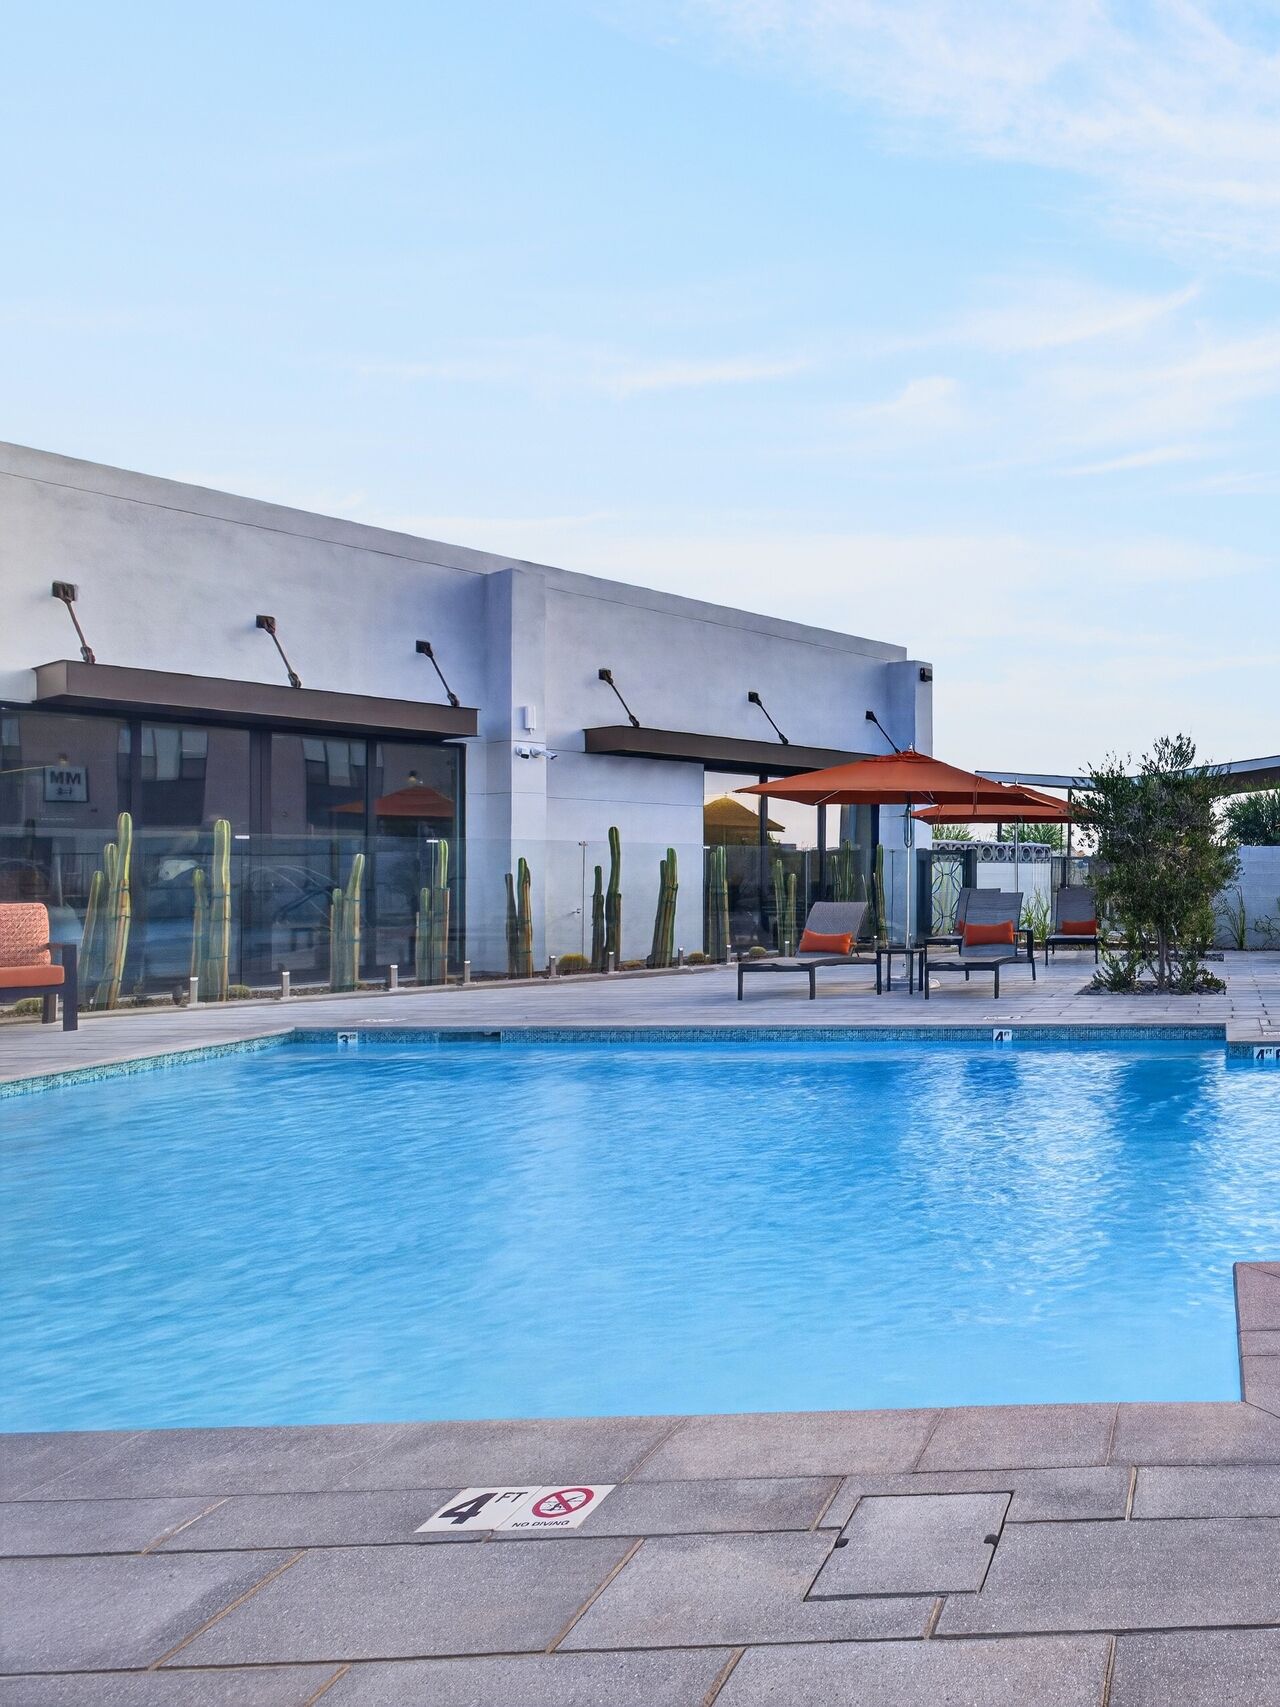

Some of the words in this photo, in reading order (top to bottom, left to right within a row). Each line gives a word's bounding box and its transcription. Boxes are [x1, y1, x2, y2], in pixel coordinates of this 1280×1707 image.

[438, 1492, 499, 1525] 4
[494, 1491, 529, 1503] FT
[531, 1519, 571, 1527] DIVING
